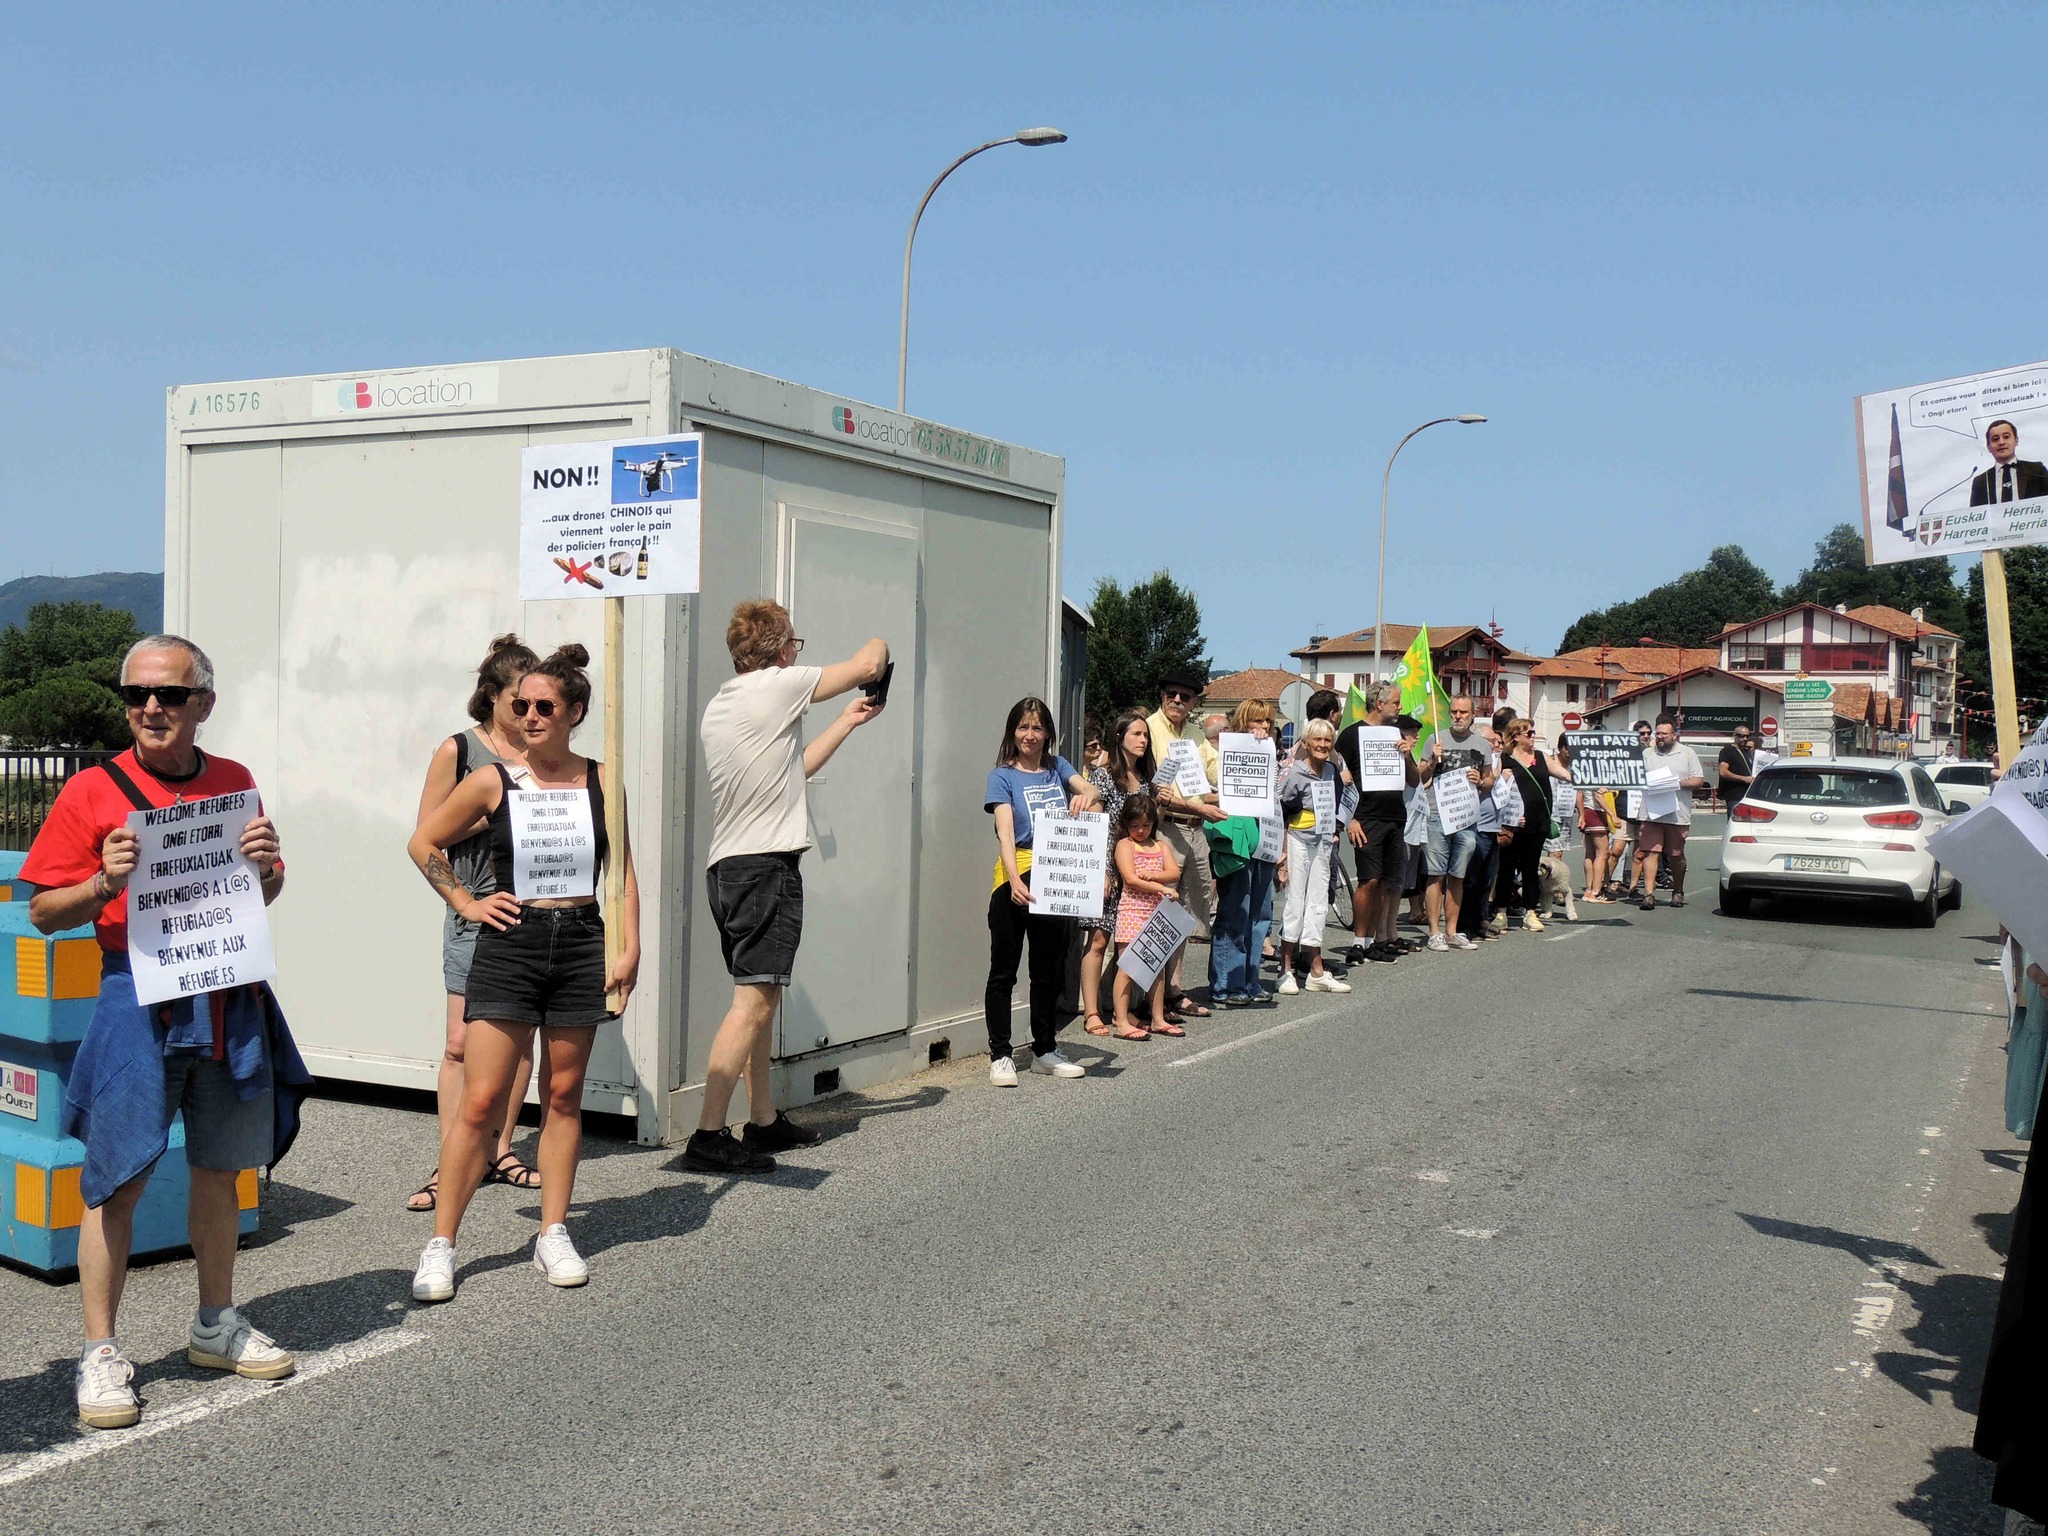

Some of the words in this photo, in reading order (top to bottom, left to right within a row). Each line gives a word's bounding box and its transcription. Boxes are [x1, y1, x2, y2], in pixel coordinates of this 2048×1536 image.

[377, 378, 472, 408] location
[1930, 396, 1957, 405] comme
[1981, 387, 2001, 395] dites
[2031, 378, 2041, 386] ici
[1928, 409, 1945, 418] Ongi
[1946, 406, 1968, 415] etorri
[1982, 393, 2035, 408] errefuxiatuak
[572, 510, 605, 521] drones
[610, 505, 653, 518] CHINOIS
[655, 504, 672, 517] qui
[1945, 510, 1988, 526] Euskal
[2002, 503, 2045, 519] Herria,
[560, 525, 603, 537] viennent
[610, 521, 634, 534] voler
[636, 521, 646, 531] le
[648, 520, 672, 533] pain
[1943, 526, 1989, 541] Harrera
[547, 541, 563, 553] des
[565, 539, 606, 554] policiers
[1365, 741, 1397, 751] ninguna
[1567, 735, 1600, 746] Mon
[1602, 735, 1639, 746] PAYS
[1226, 752, 1266, 765] ninguna
[1366, 751, 1397, 760] persona
[1579, 748, 1630, 759] s'appelle
[1225, 766, 1265, 776] persona
[1571, 759, 1646, 785] SOLIDARITE
[518, 793, 548, 803] WELCOME
[549, 792, 578, 802] REFUGEES
[1233, 785, 1258, 797] ilegal
[144, 801, 196, 827] WELCOME
[199, 793, 246, 816] REFUGEES
[532, 808, 546, 817] ONGI
[547, 807, 568, 817] ETORRI
[1077, 812, 1101, 823] EFUGEES
[527, 821, 577, 832] ERREFUXIATUAK
[1054, 825, 1068, 836] ONGI
[1069, 826, 1089, 837] ETORRI
[162, 831, 187, 849] ONGI
[189, 823, 224, 845] ETORRI
[564, 837, 570, 847] A
[1046, 841, 1093, 853] ERREFUXIATUAK
[150, 848, 234, 880] ERREFUXIATUAK
[1079, 859, 1084, 869] A
[1793, 856, 1821, 868] 7629
[1825, 858, 1846, 869] KGY
[528, 869, 562, 880] BIENVENUE
[563, 868, 577, 878] AUX
[138, 881, 209, 911] BIENVENID@S
[212, 883, 222, 896] A
[224, 874, 250, 895] L@S
[1043, 887, 1074, 899] BIENVENUE
[1076, 890, 1090, 900] AUX
[161, 907, 233, 935] REFUGIAD@S
[1153, 915, 1178, 942] ninguna
[1147, 925, 1171, 952] persona
[157, 939, 219, 967] BIENVENUE
[222, 934, 247, 952] AUX
[1138, 946, 1157, 966] ilegal
[178, 962, 236, 992] RÉFUGIÉ.ES
